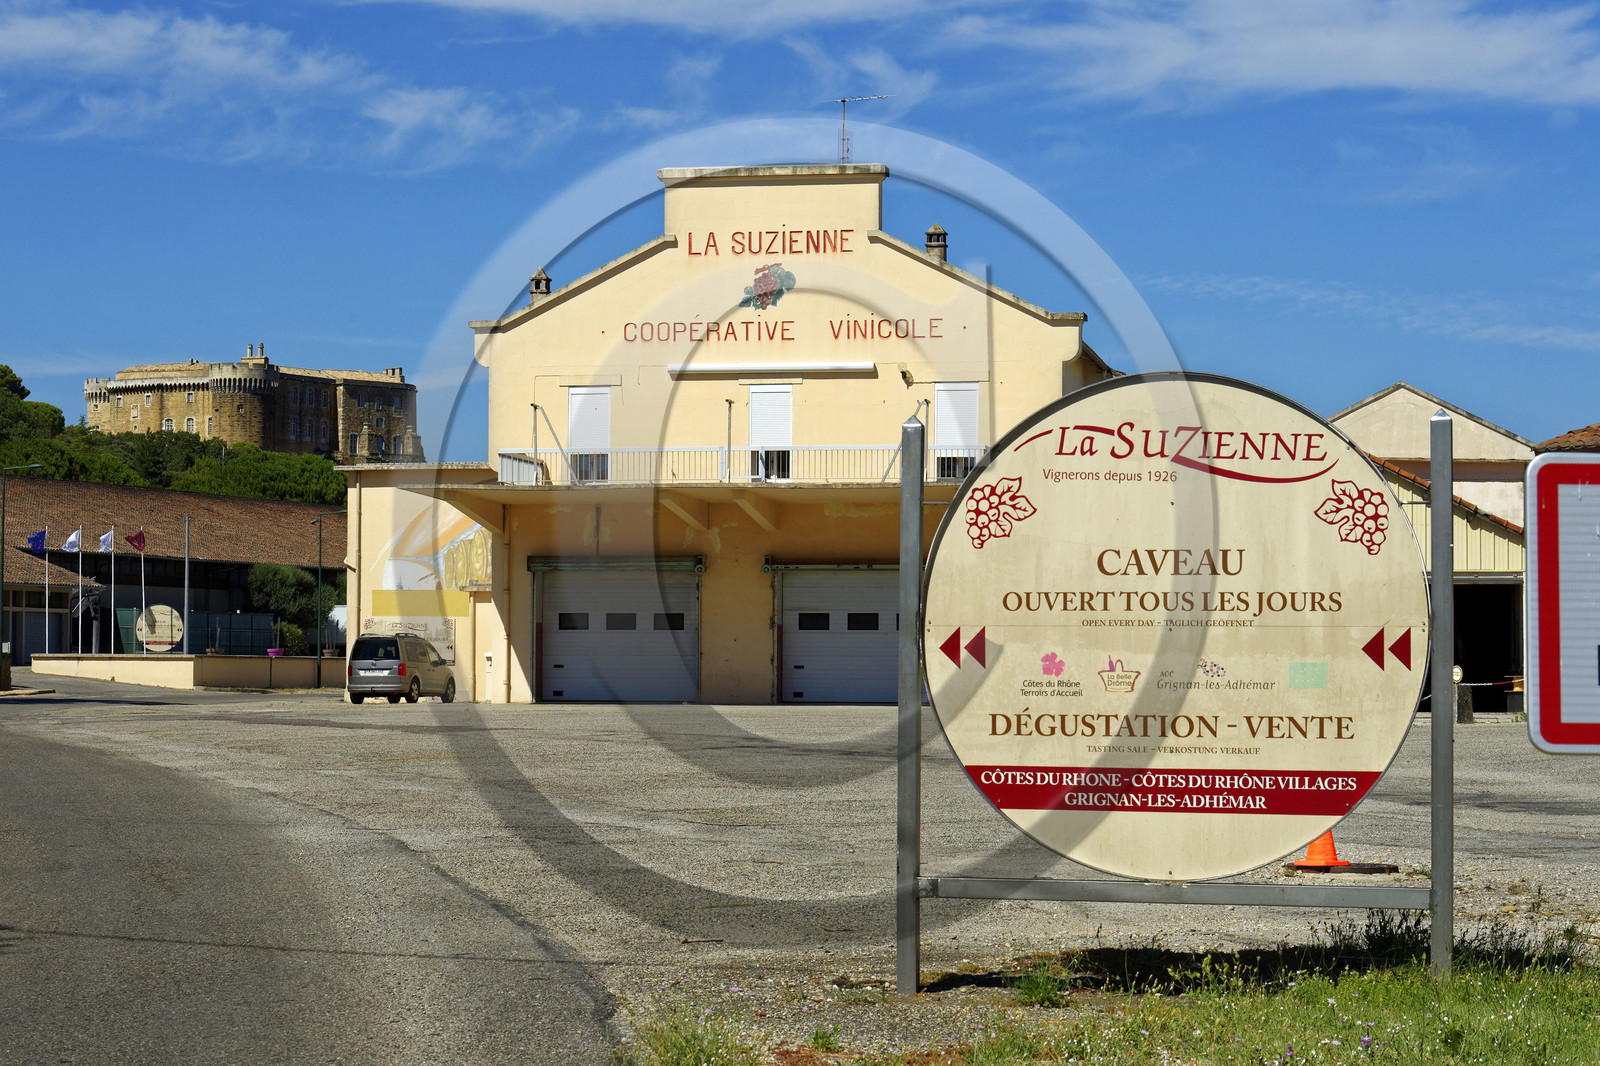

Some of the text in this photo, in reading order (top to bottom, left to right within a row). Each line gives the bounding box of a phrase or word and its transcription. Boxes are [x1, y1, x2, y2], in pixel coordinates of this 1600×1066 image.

[688, 224, 855, 256] LA SUZIENNE
[623, 313, 944, 343] COOPÉRATIVE VINICOLE
[1055, 426, 1098, 456] La
[1042, 469, 1178, 483] Vignerons depuis 1926
[1097, 548, 1246, 577] CAVEAU
[1002, 591, 1343, 618] OUVERT TOUS LES JOURS
[1081, 619, 1106, 627] OPEN
[1108, 619, 1136, 627] EVERY
[1137, 619, 1155, 627] DAY
[1205, 618, 1255, 627] GEÖFFNET
[1022, 680, 1081, 688] Côtes du Rhône
[1107, 679, 1132, 687] Drôme
[1156, 679, 1276, 692] Grignan-les-Adhémar
[1020, 689, 1083, 697] Terroirs d'Accueil
[988, 707, 1219, 738] DÉGUSTATION
[1243, 715, 1355, 740] VENTE
[1086, 745, 1126, 753] TASTING
[1127, 745, 1149, 753] SALE
[1158, 746, 1219, 754] VERKOSTUNG
[1220, 747, 1261, 755] VERKAUF
[980, 769, 1034, 785] CÔTES
[1035, 772, 1062, 786] DU
[1062, 772, 1122, 787] RHONE
[1131, 771, 1186, 788] CÔTES
[1187, 774, 1213, 788] DU
[1215, 772, 1276, 790] RHÔNE
[1276, 776, 1357, 791] VILLAGES
[1064, 791, 1268, 809] GRIGNAN-LES-ADHÉMAR
